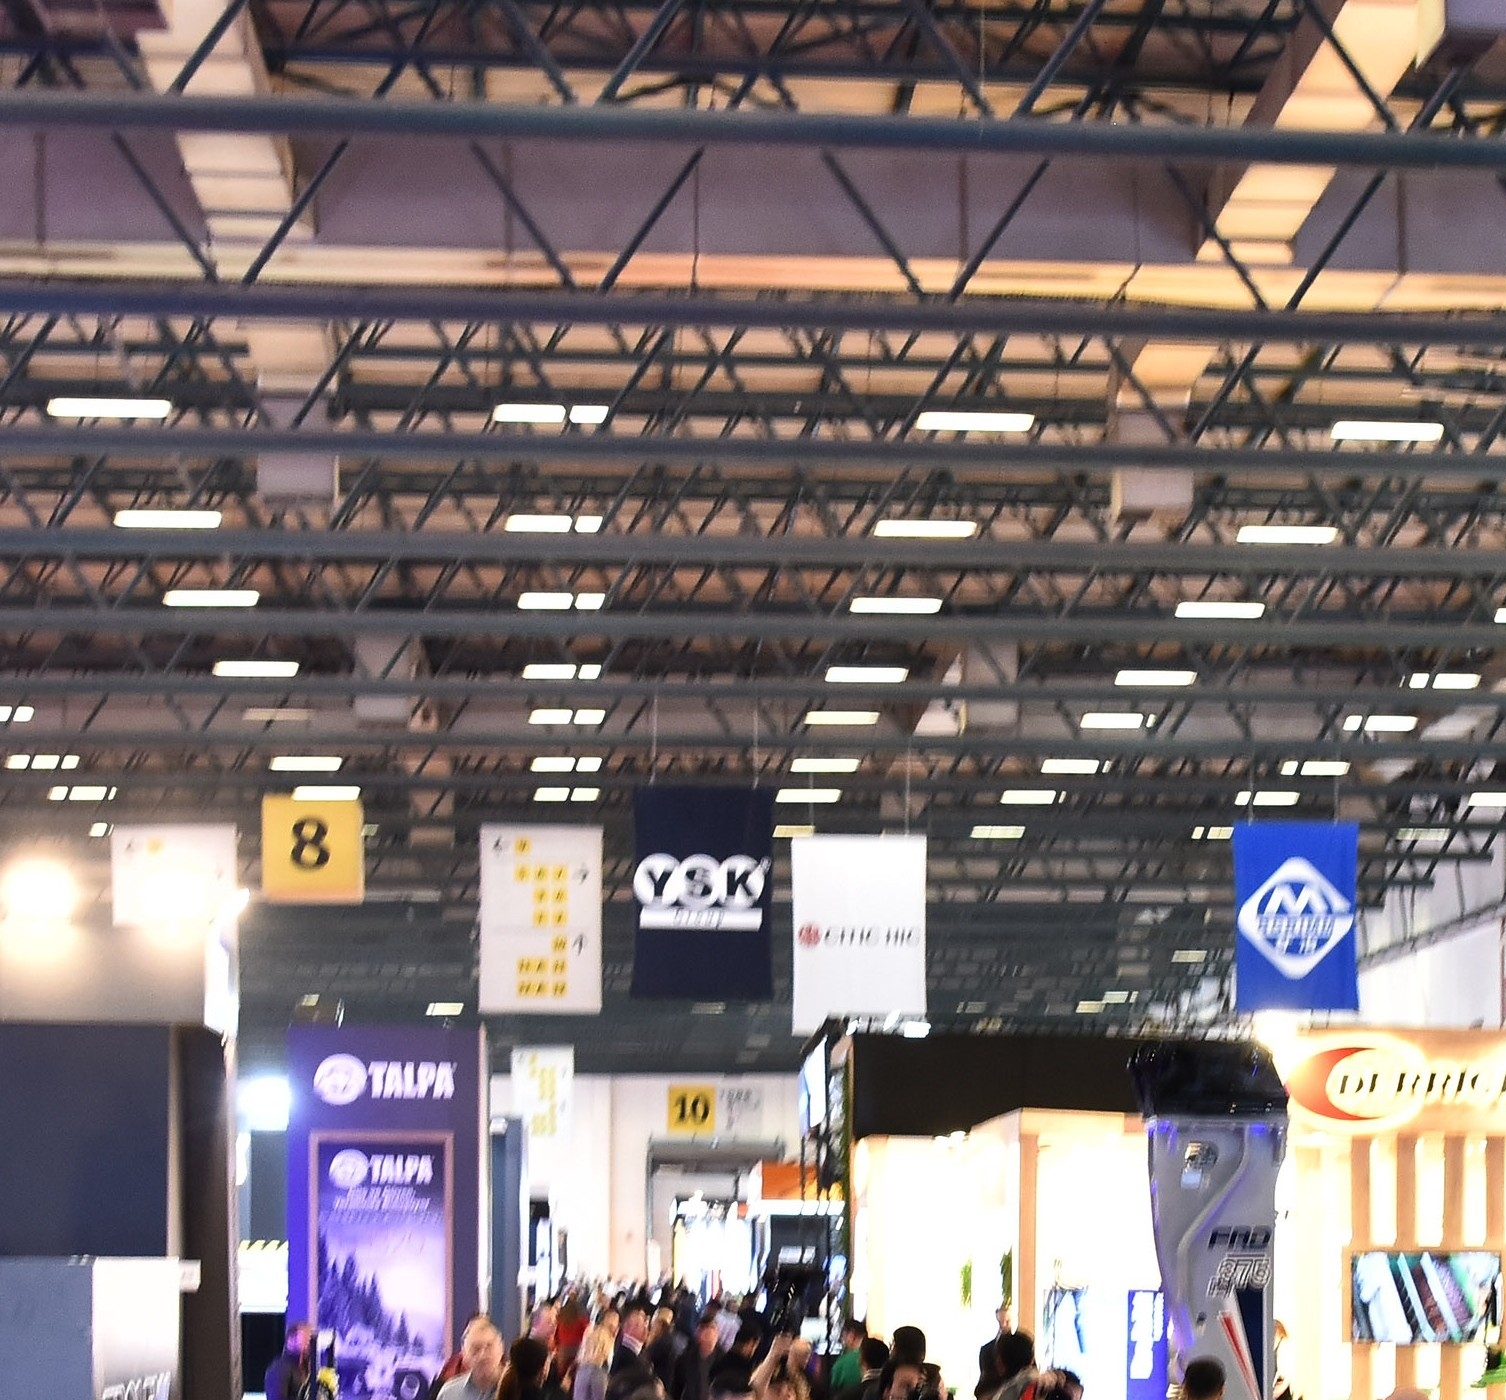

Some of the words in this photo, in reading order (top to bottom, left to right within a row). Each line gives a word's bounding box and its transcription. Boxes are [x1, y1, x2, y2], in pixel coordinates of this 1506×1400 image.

[291, 816, 330, 870] 8
[642, 861, 759, 901] YSK
[368, 1061, 456, 1099] TALPA
[673, 1091, 710, 1126] 10
[369, 1154, 433, 1184] TALPA
[1208, 1227, 1273, 1250] FRD
